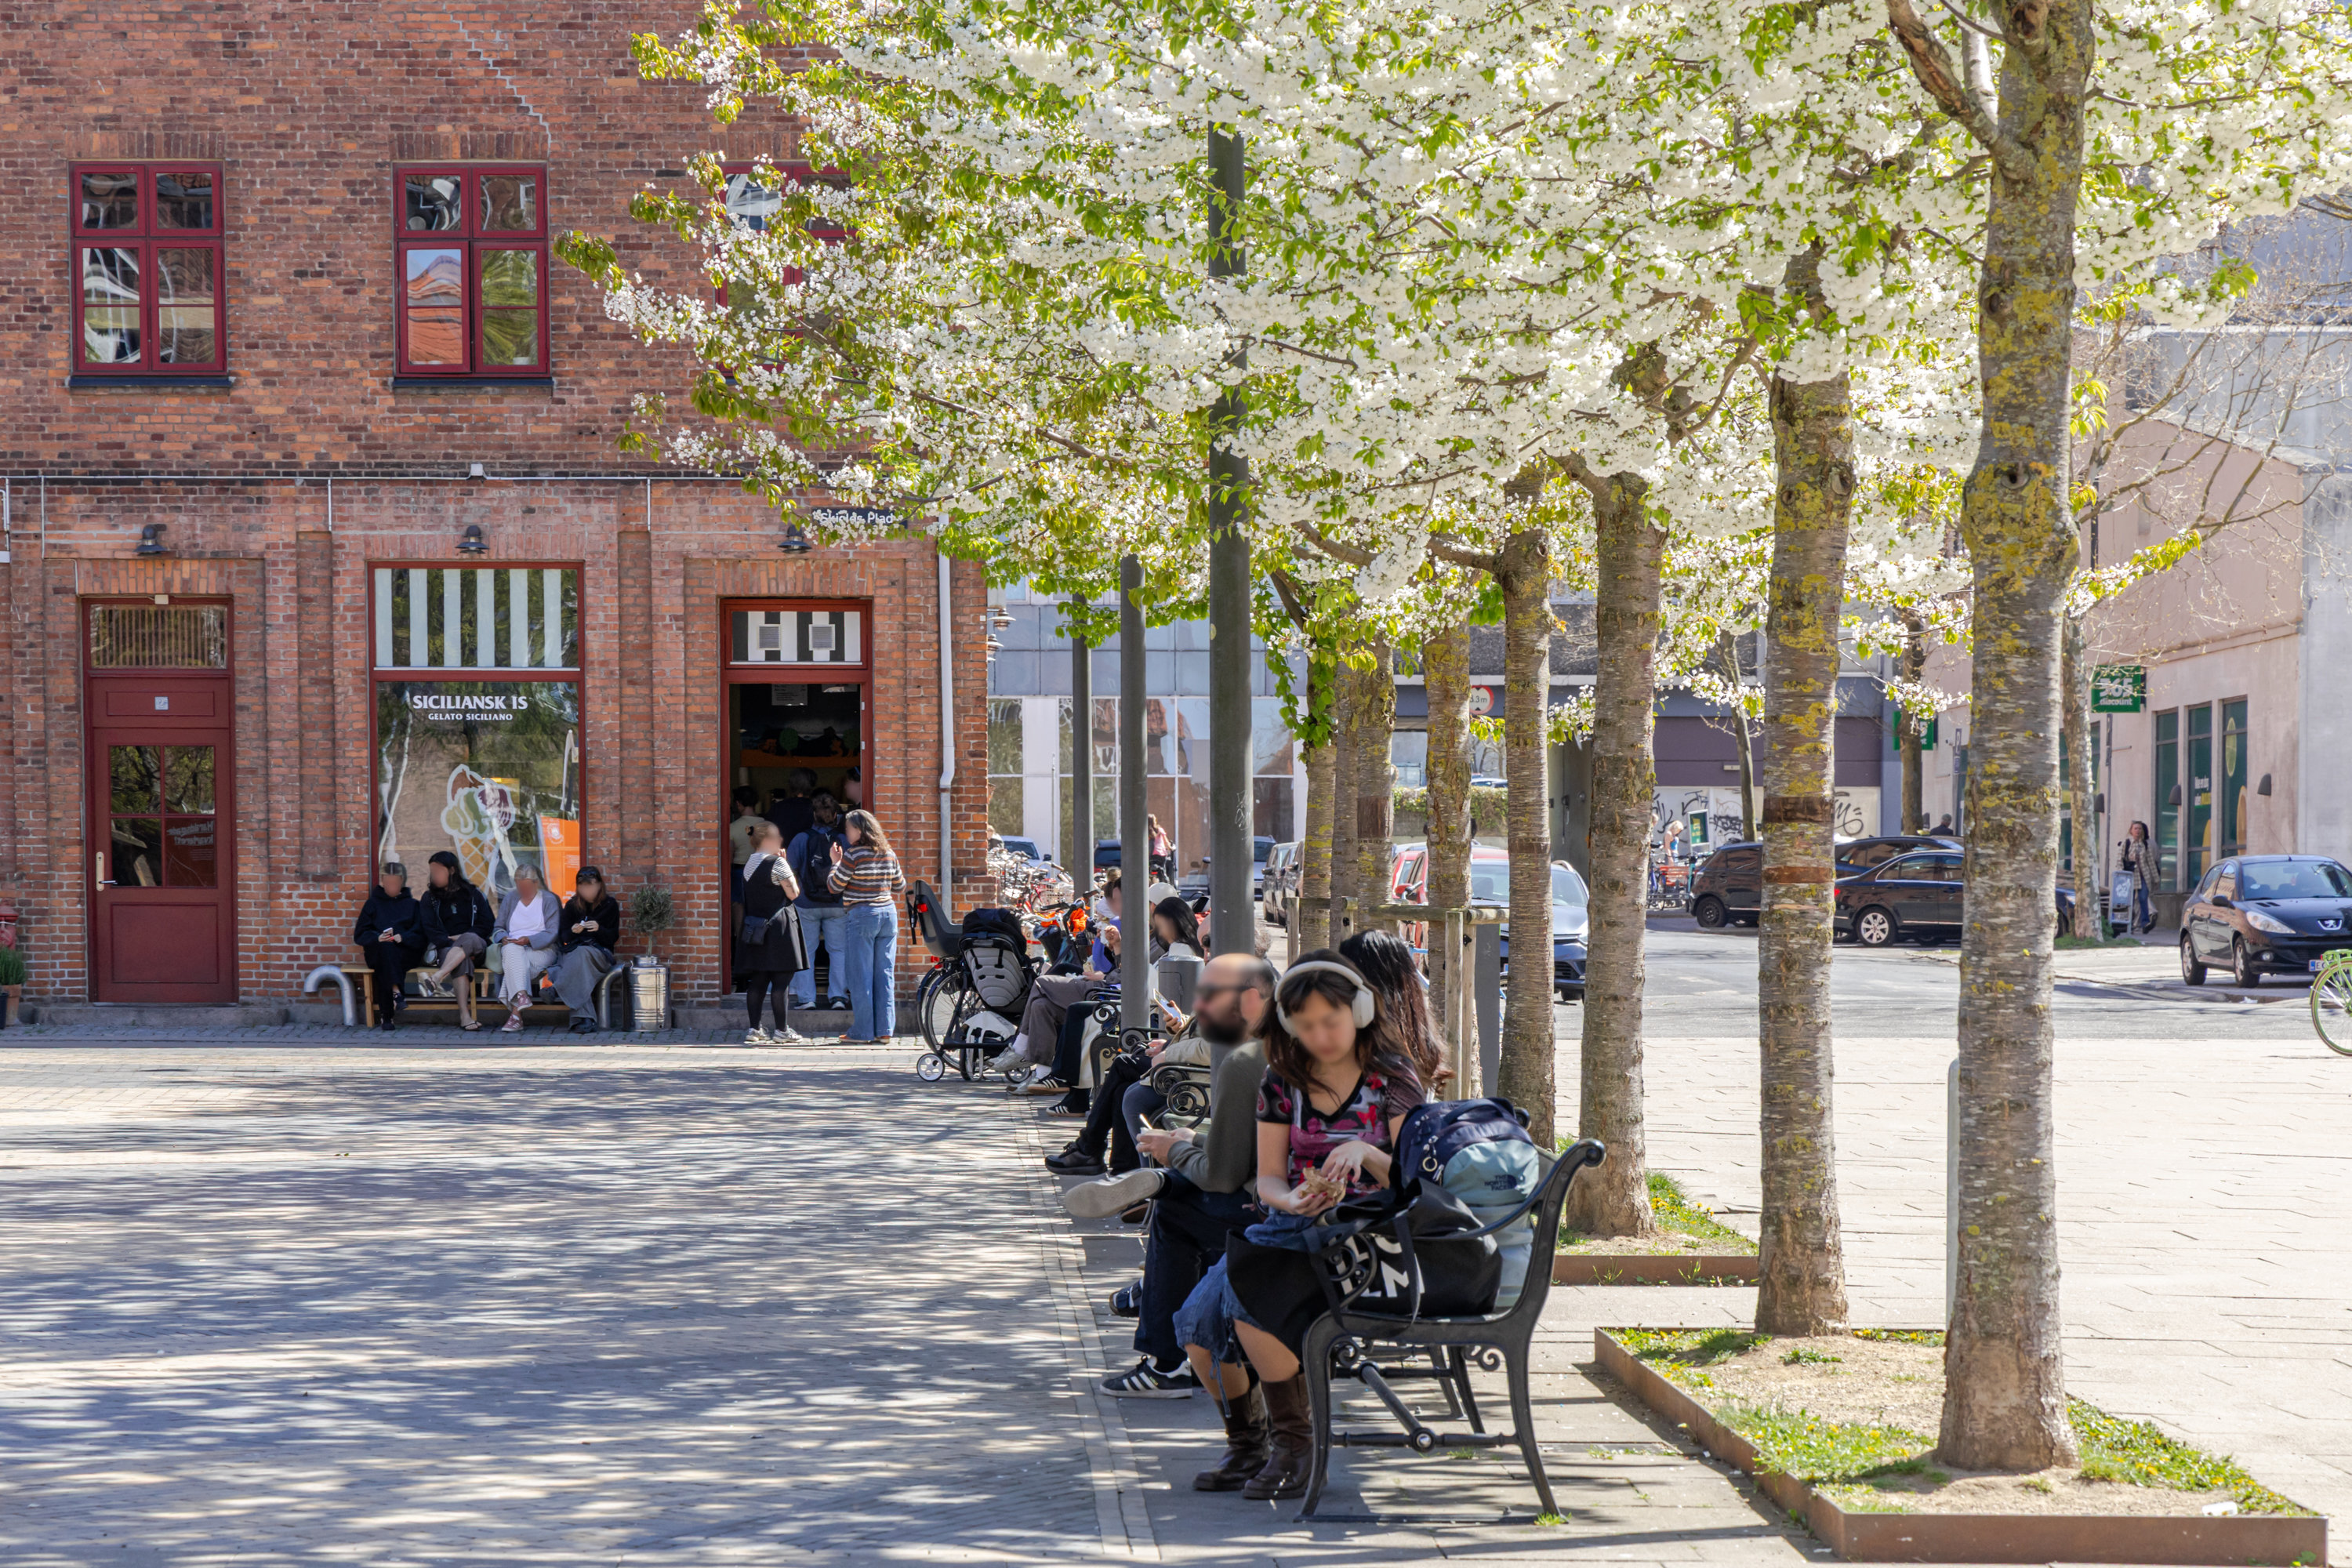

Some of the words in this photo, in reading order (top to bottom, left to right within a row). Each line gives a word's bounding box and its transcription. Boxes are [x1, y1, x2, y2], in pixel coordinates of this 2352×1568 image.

[867, 512, 895, 524] Plad
[2100, 678, 2132, 697] 365
[412, 695, 506, 710] SICILIANSK
[511, 695, 528, 710] IS
